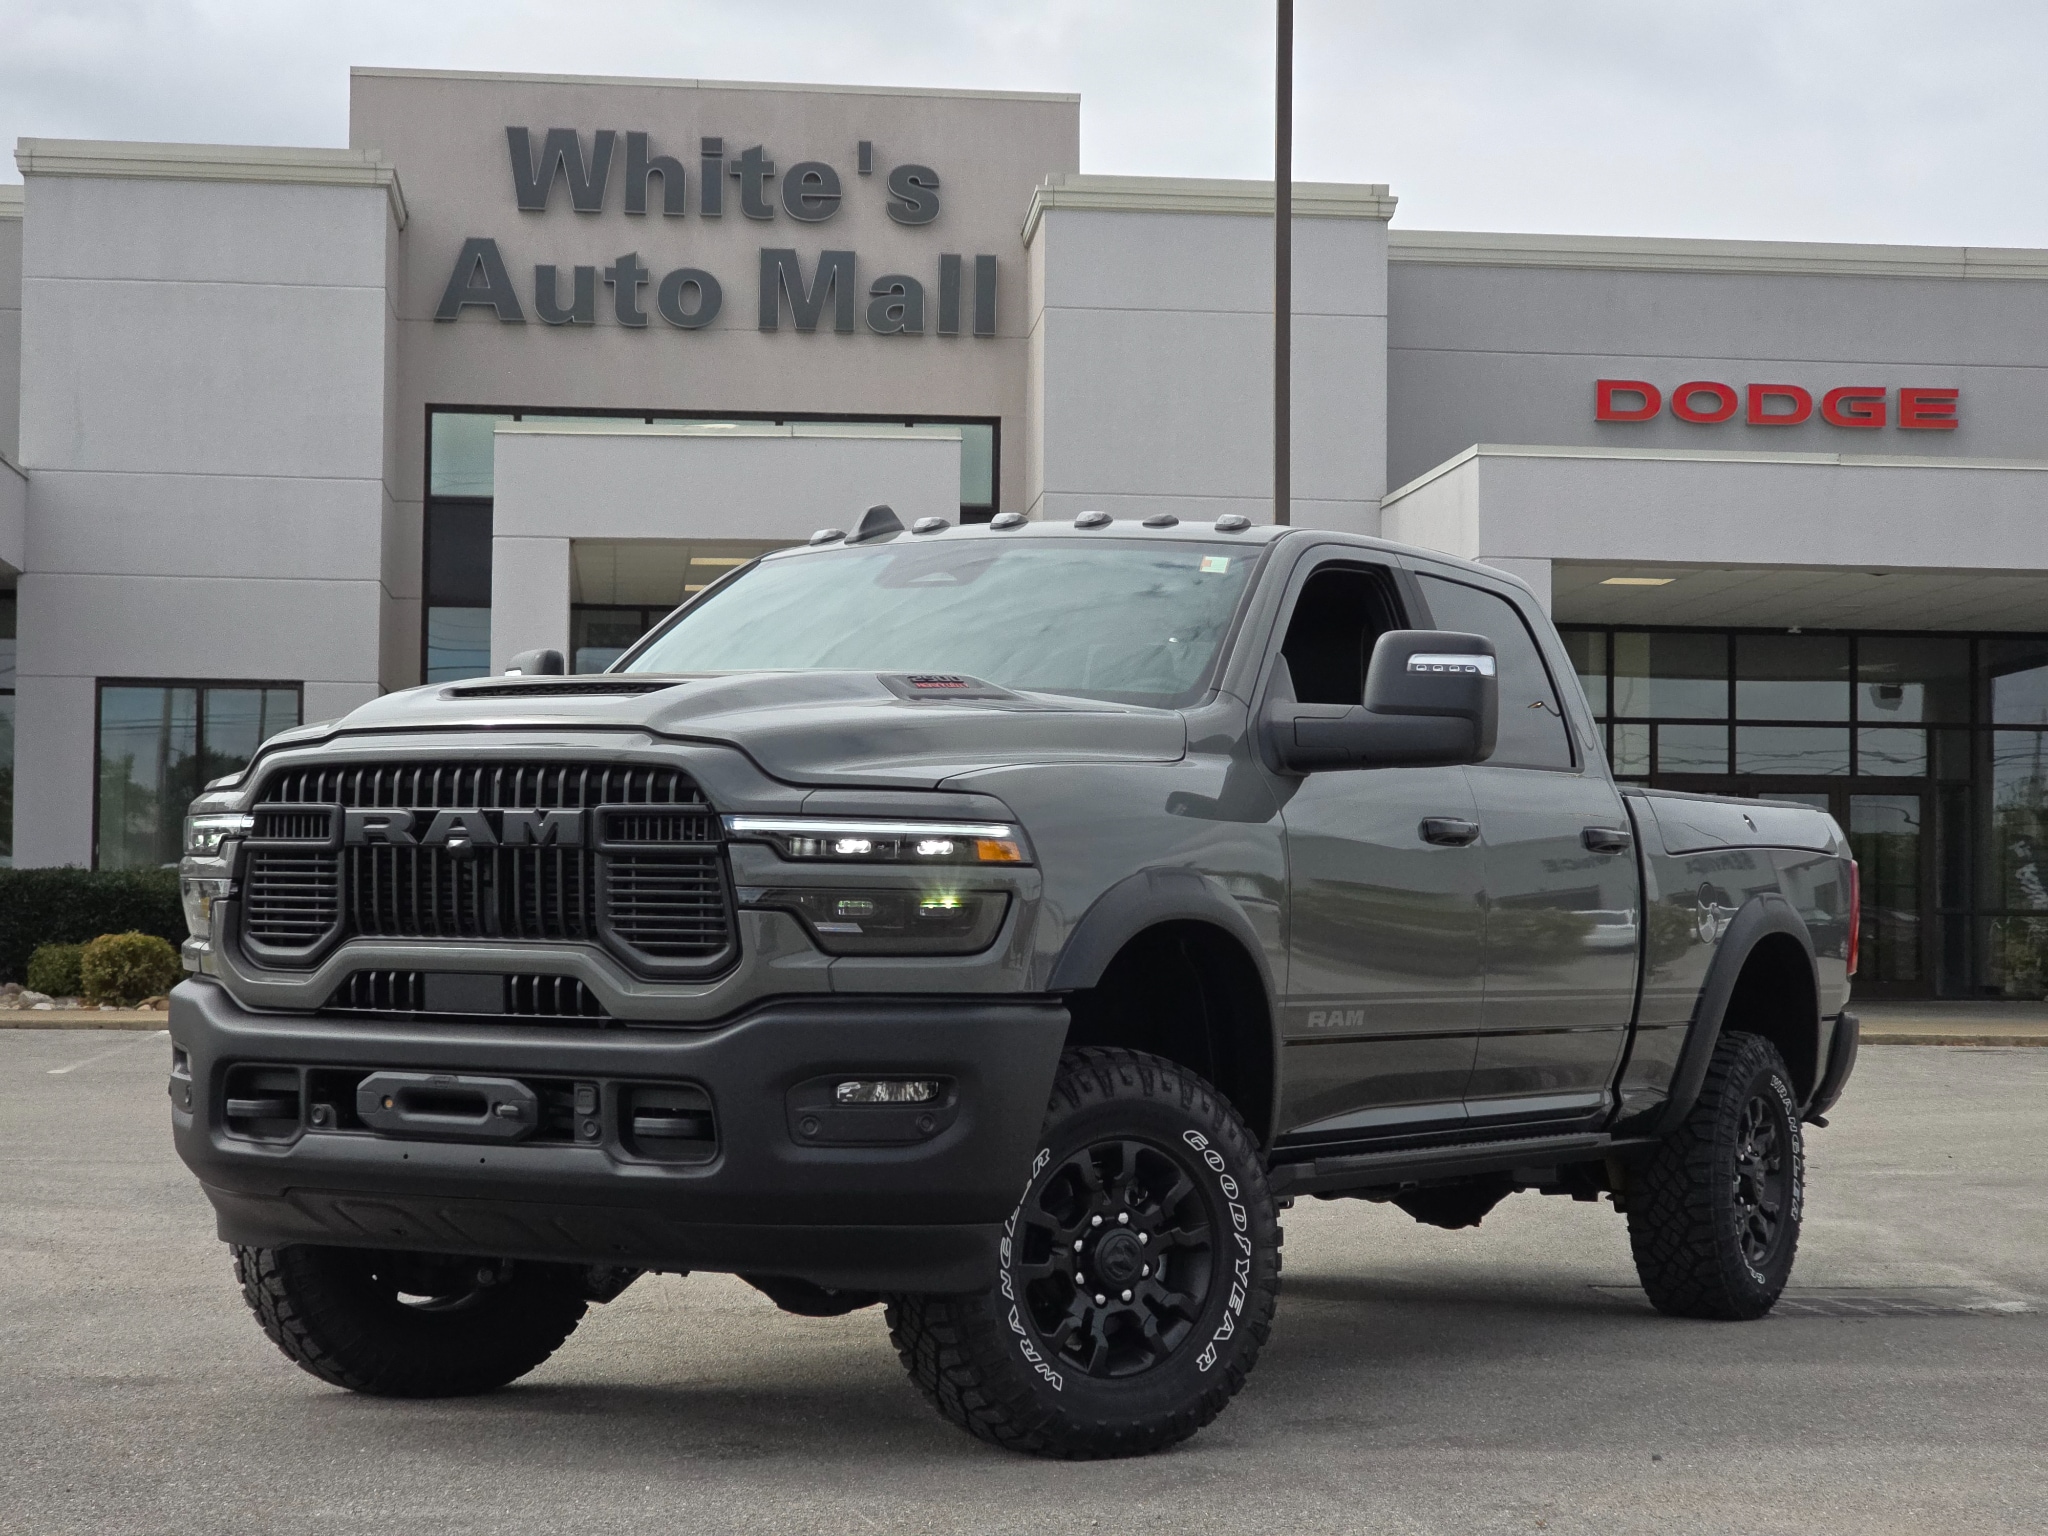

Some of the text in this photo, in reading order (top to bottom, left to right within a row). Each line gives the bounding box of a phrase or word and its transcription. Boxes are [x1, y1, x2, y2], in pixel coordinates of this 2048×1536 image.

[505, 126, 941, 225] White's
[433, 237, 999, 336] Auto Mall
[1594, 379, 1960, 430] DODGE
[344, 808, 584, 847] RAM
[1307, 1010, 1365, 1028] RAM
[1769, 1074, 1801, 1222] WRANGLER
[1000, 1148, 1063, 1391] WRANGLR
[1182, 1130, 1252, 1372] GOODYEAR
